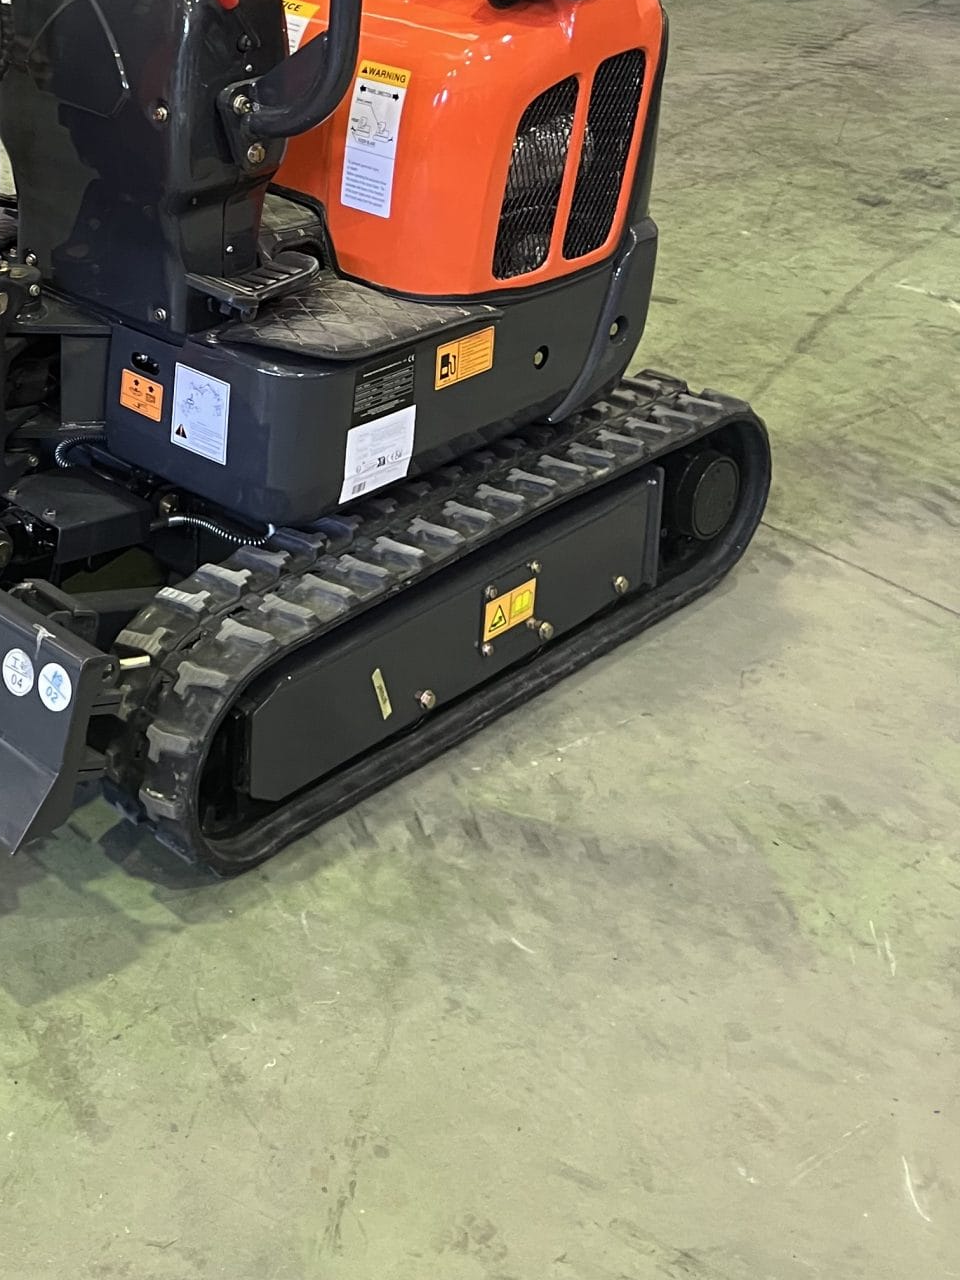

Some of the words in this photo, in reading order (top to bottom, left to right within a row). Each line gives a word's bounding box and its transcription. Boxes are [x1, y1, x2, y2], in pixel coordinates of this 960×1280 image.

[281, 0, 303, 12] ICE
[368, 66, 407, 84] WARNING
[45, 686, 59, 705] 02
